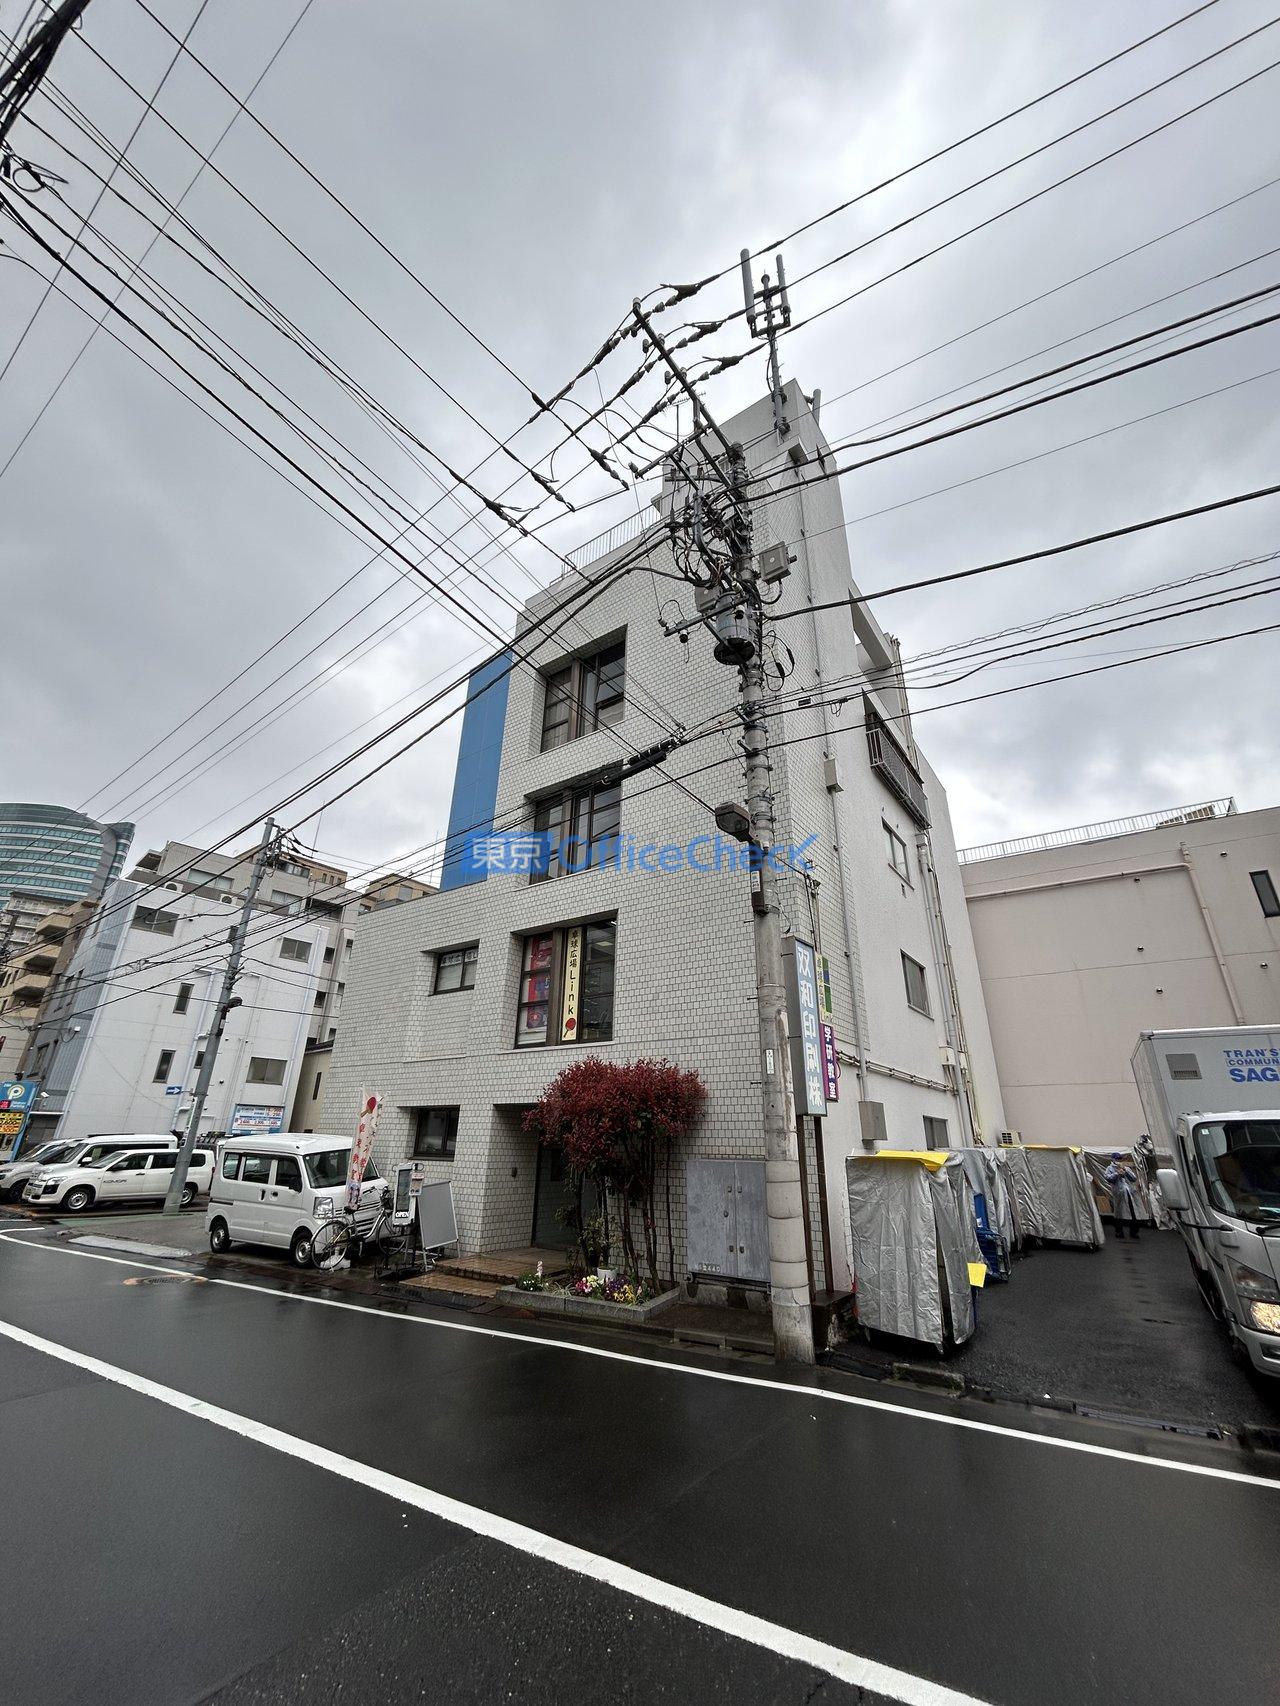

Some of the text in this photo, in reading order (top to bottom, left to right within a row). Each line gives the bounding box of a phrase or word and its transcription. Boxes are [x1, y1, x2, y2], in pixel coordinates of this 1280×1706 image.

[825, 1025, 837, 1098] 学研教室
[1230, 1067, 1280, 1082] SAG
